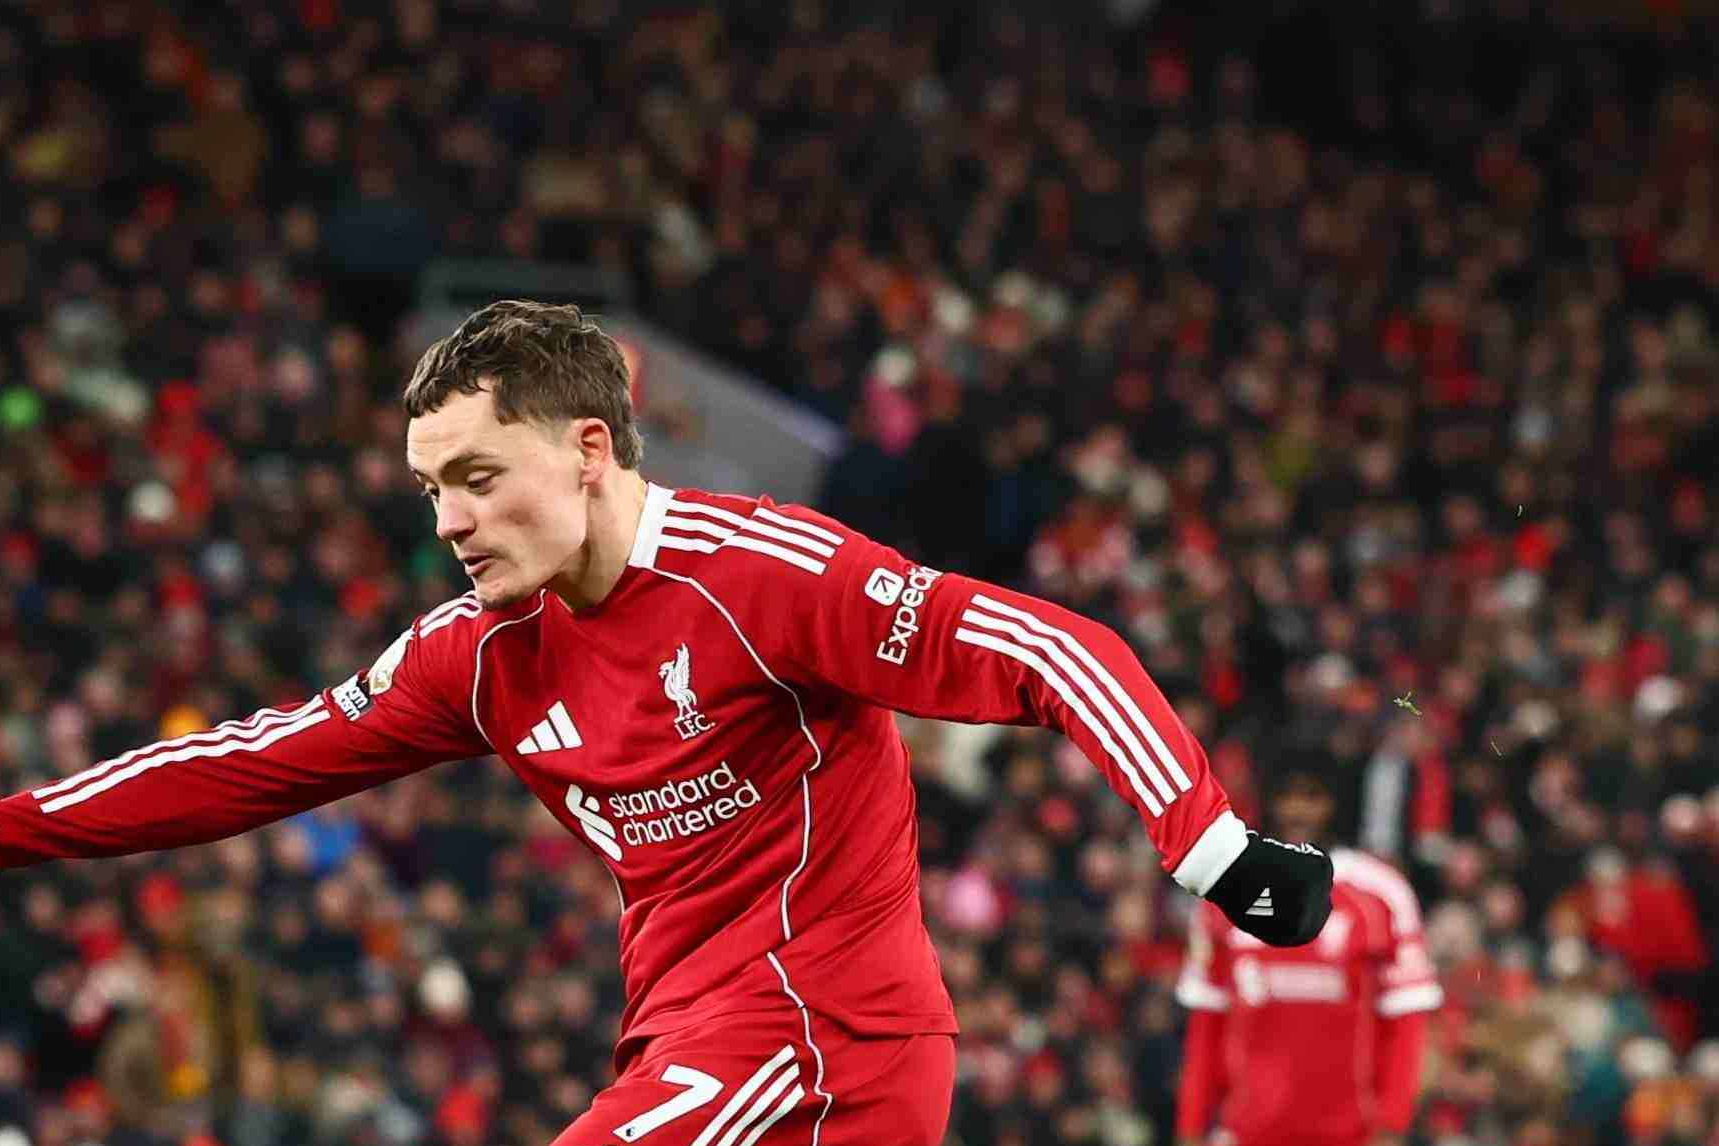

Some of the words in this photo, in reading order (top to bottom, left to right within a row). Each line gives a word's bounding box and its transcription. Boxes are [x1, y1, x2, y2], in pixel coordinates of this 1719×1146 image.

[608, 760, 737, 818] standard
[623, 779, 762, 846] chartered
[612, 1063, 725, 1143] 7
